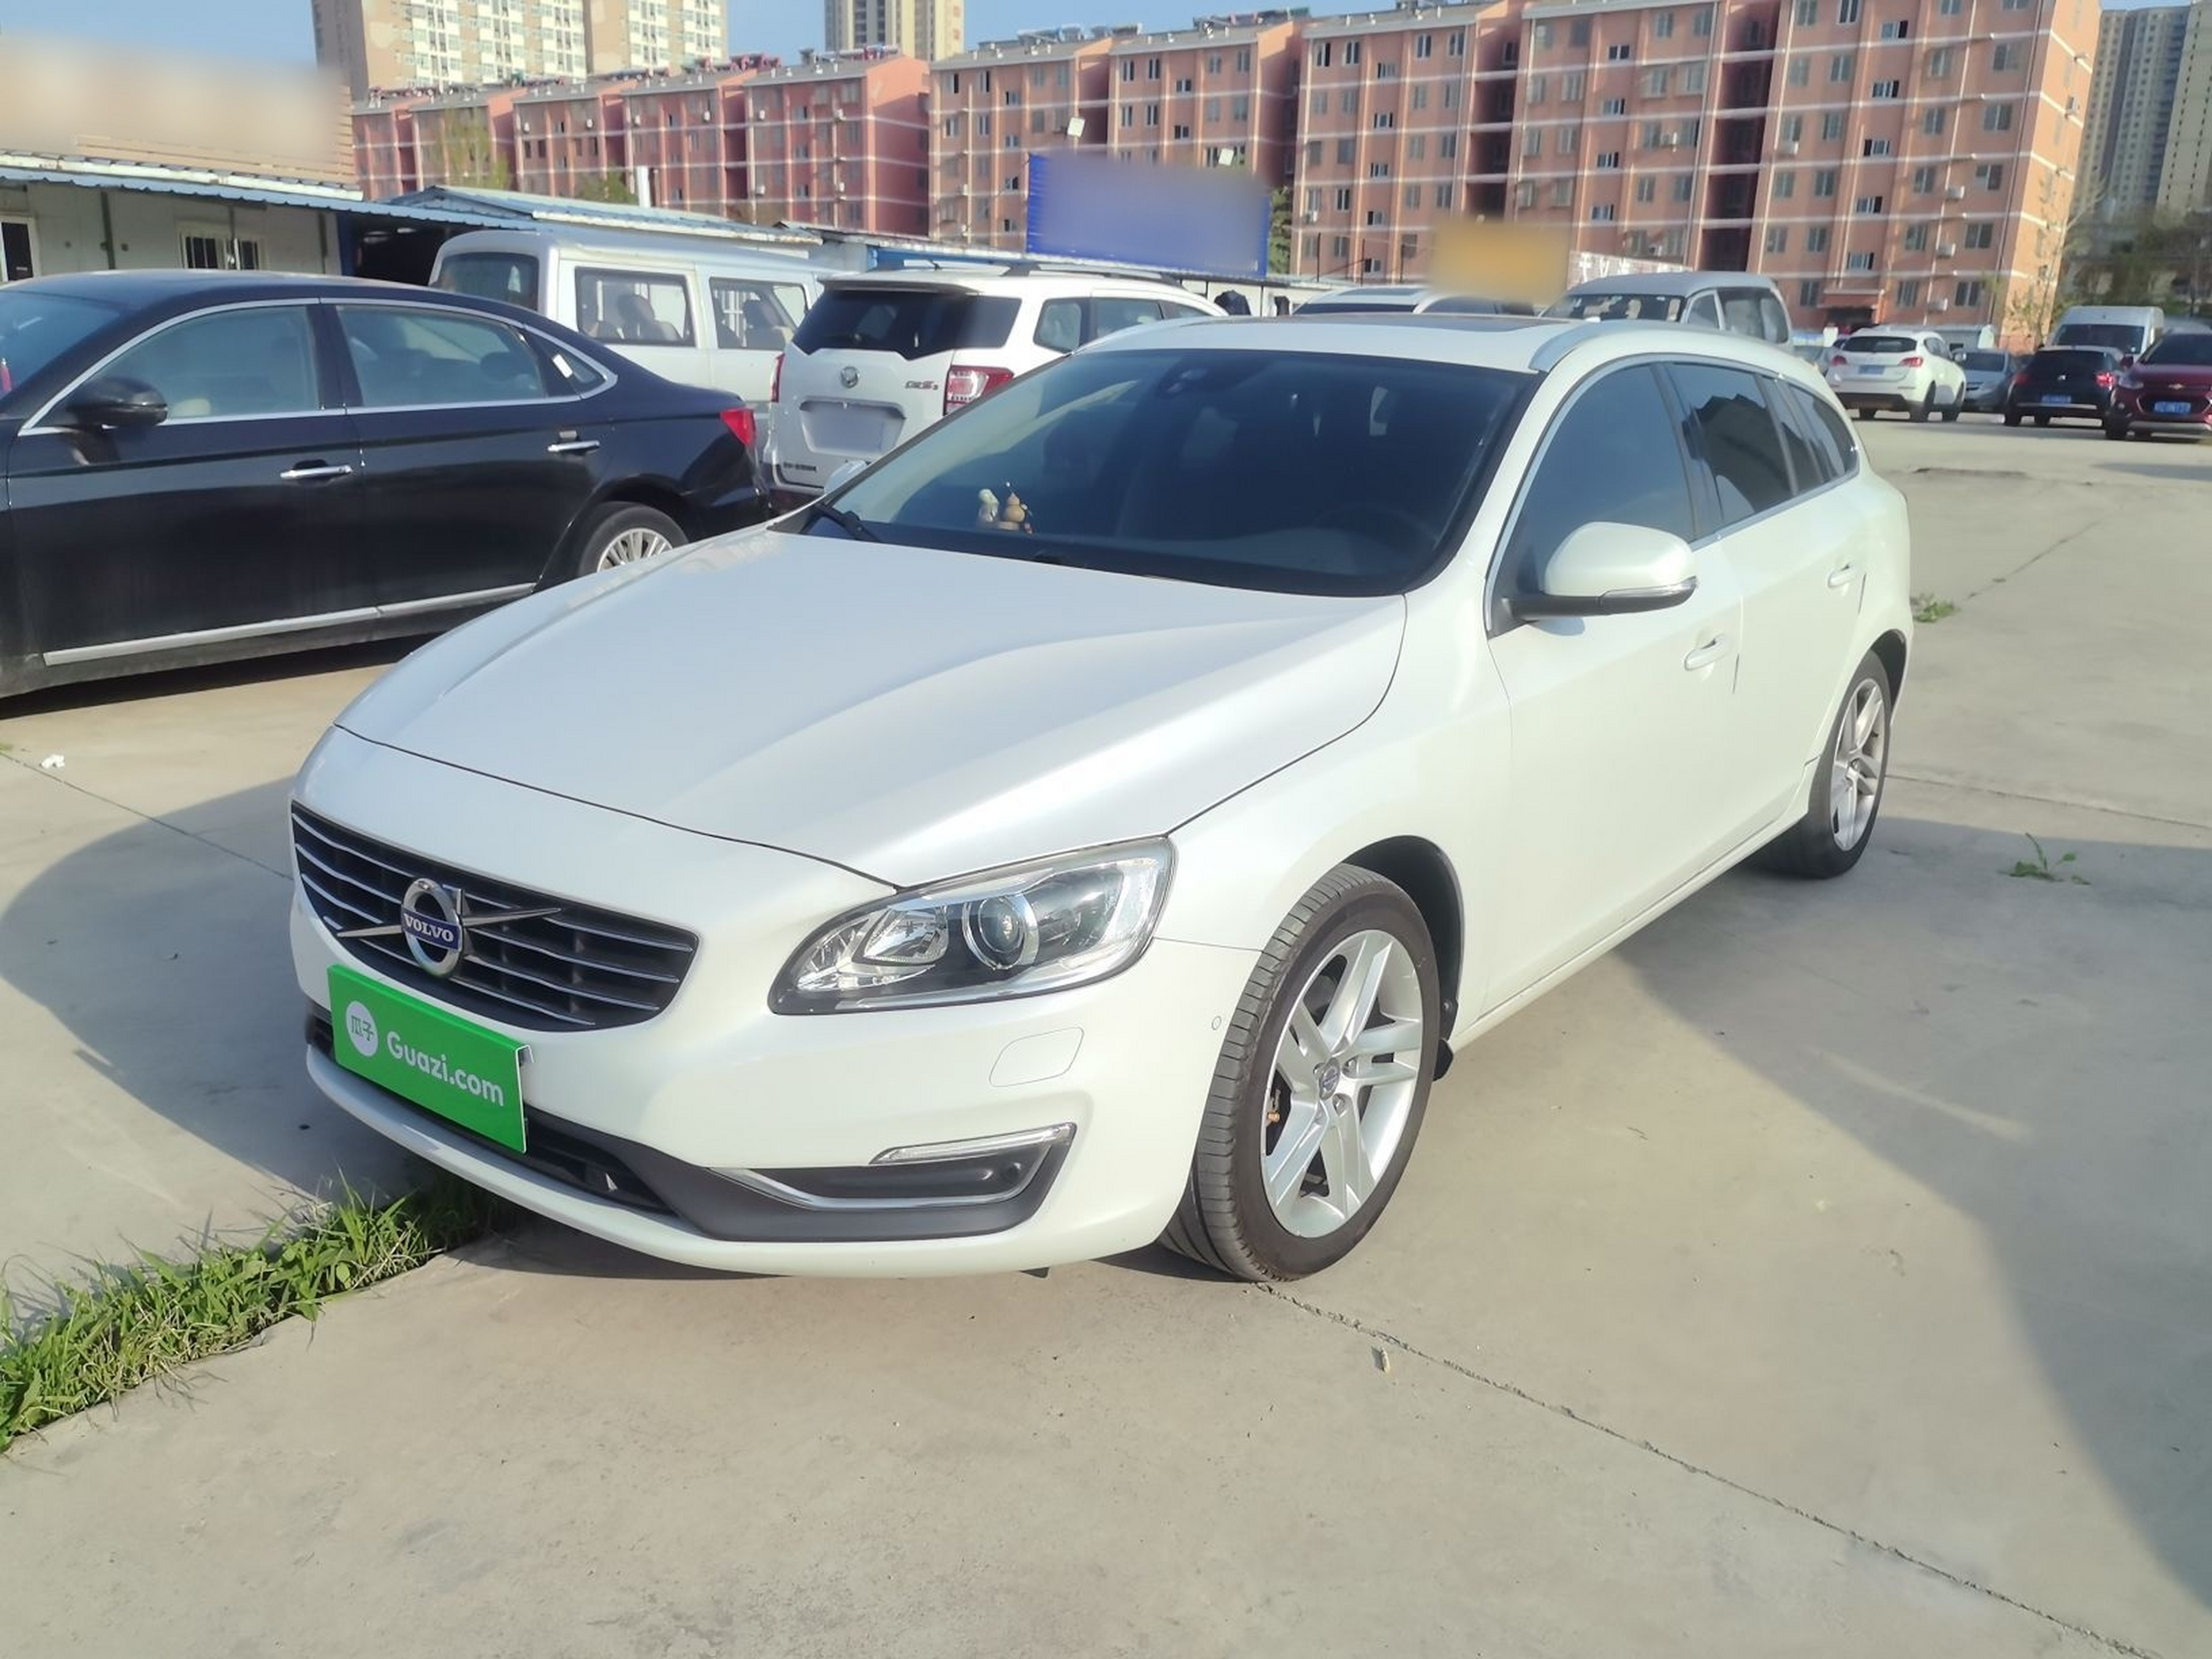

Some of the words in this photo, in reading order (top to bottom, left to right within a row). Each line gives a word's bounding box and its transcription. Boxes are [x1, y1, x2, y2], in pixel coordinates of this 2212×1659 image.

[404, 913, 454, 942] VOLVO
[351, 1015, 374, 1041] 瓜子
[387, 1031, 504, 1107] Guazi.com
